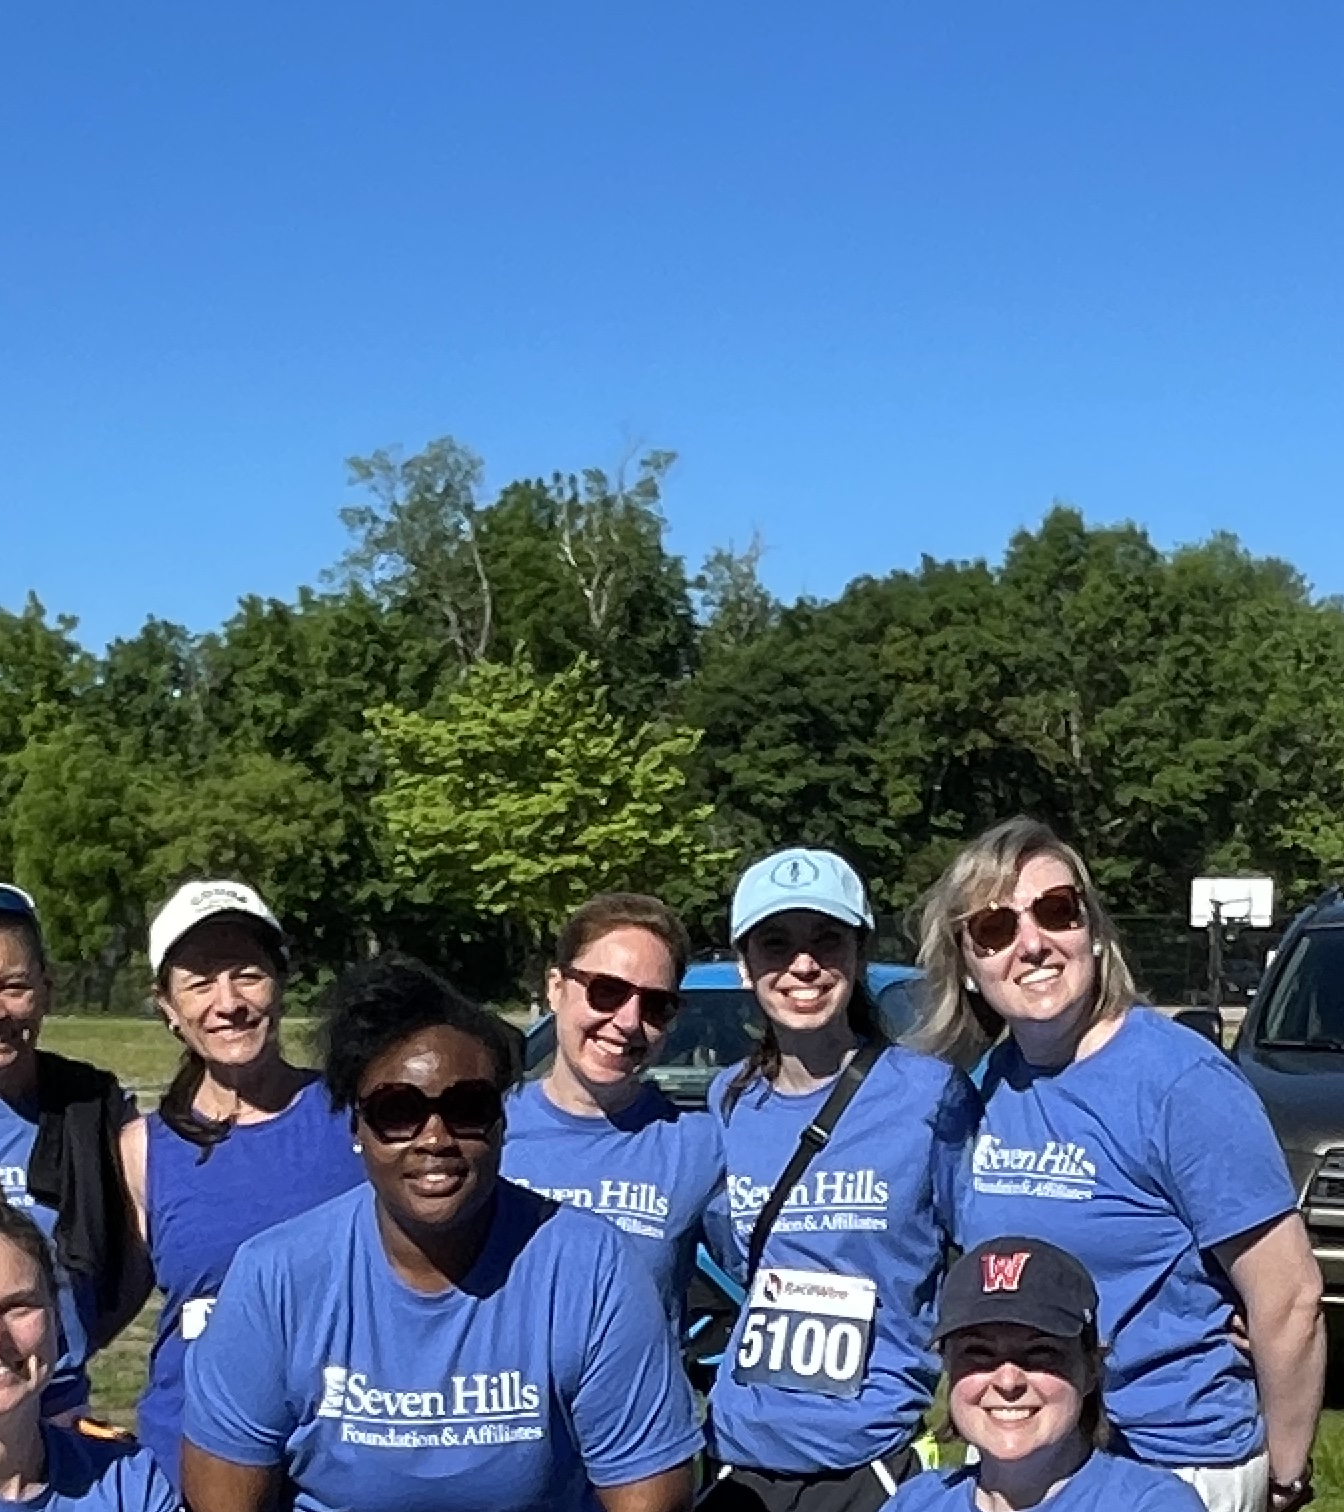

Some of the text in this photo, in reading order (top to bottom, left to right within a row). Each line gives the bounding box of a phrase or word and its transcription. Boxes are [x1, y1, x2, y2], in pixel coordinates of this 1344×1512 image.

[598, 1180, 669, 1216] Hills
[814, 1169, 889, 1205] Hills
[804, 1213, 818, 1232] &
[820, 1212, 889, 1231] Affiliates
[980, 1251, 1032, 1293] W
[738, 1313, 863, 1381] 5100
[345, 1370, 541, 1418] Seven Hills
[341, 1421, 544, 1448] Foundation & Affiliates
